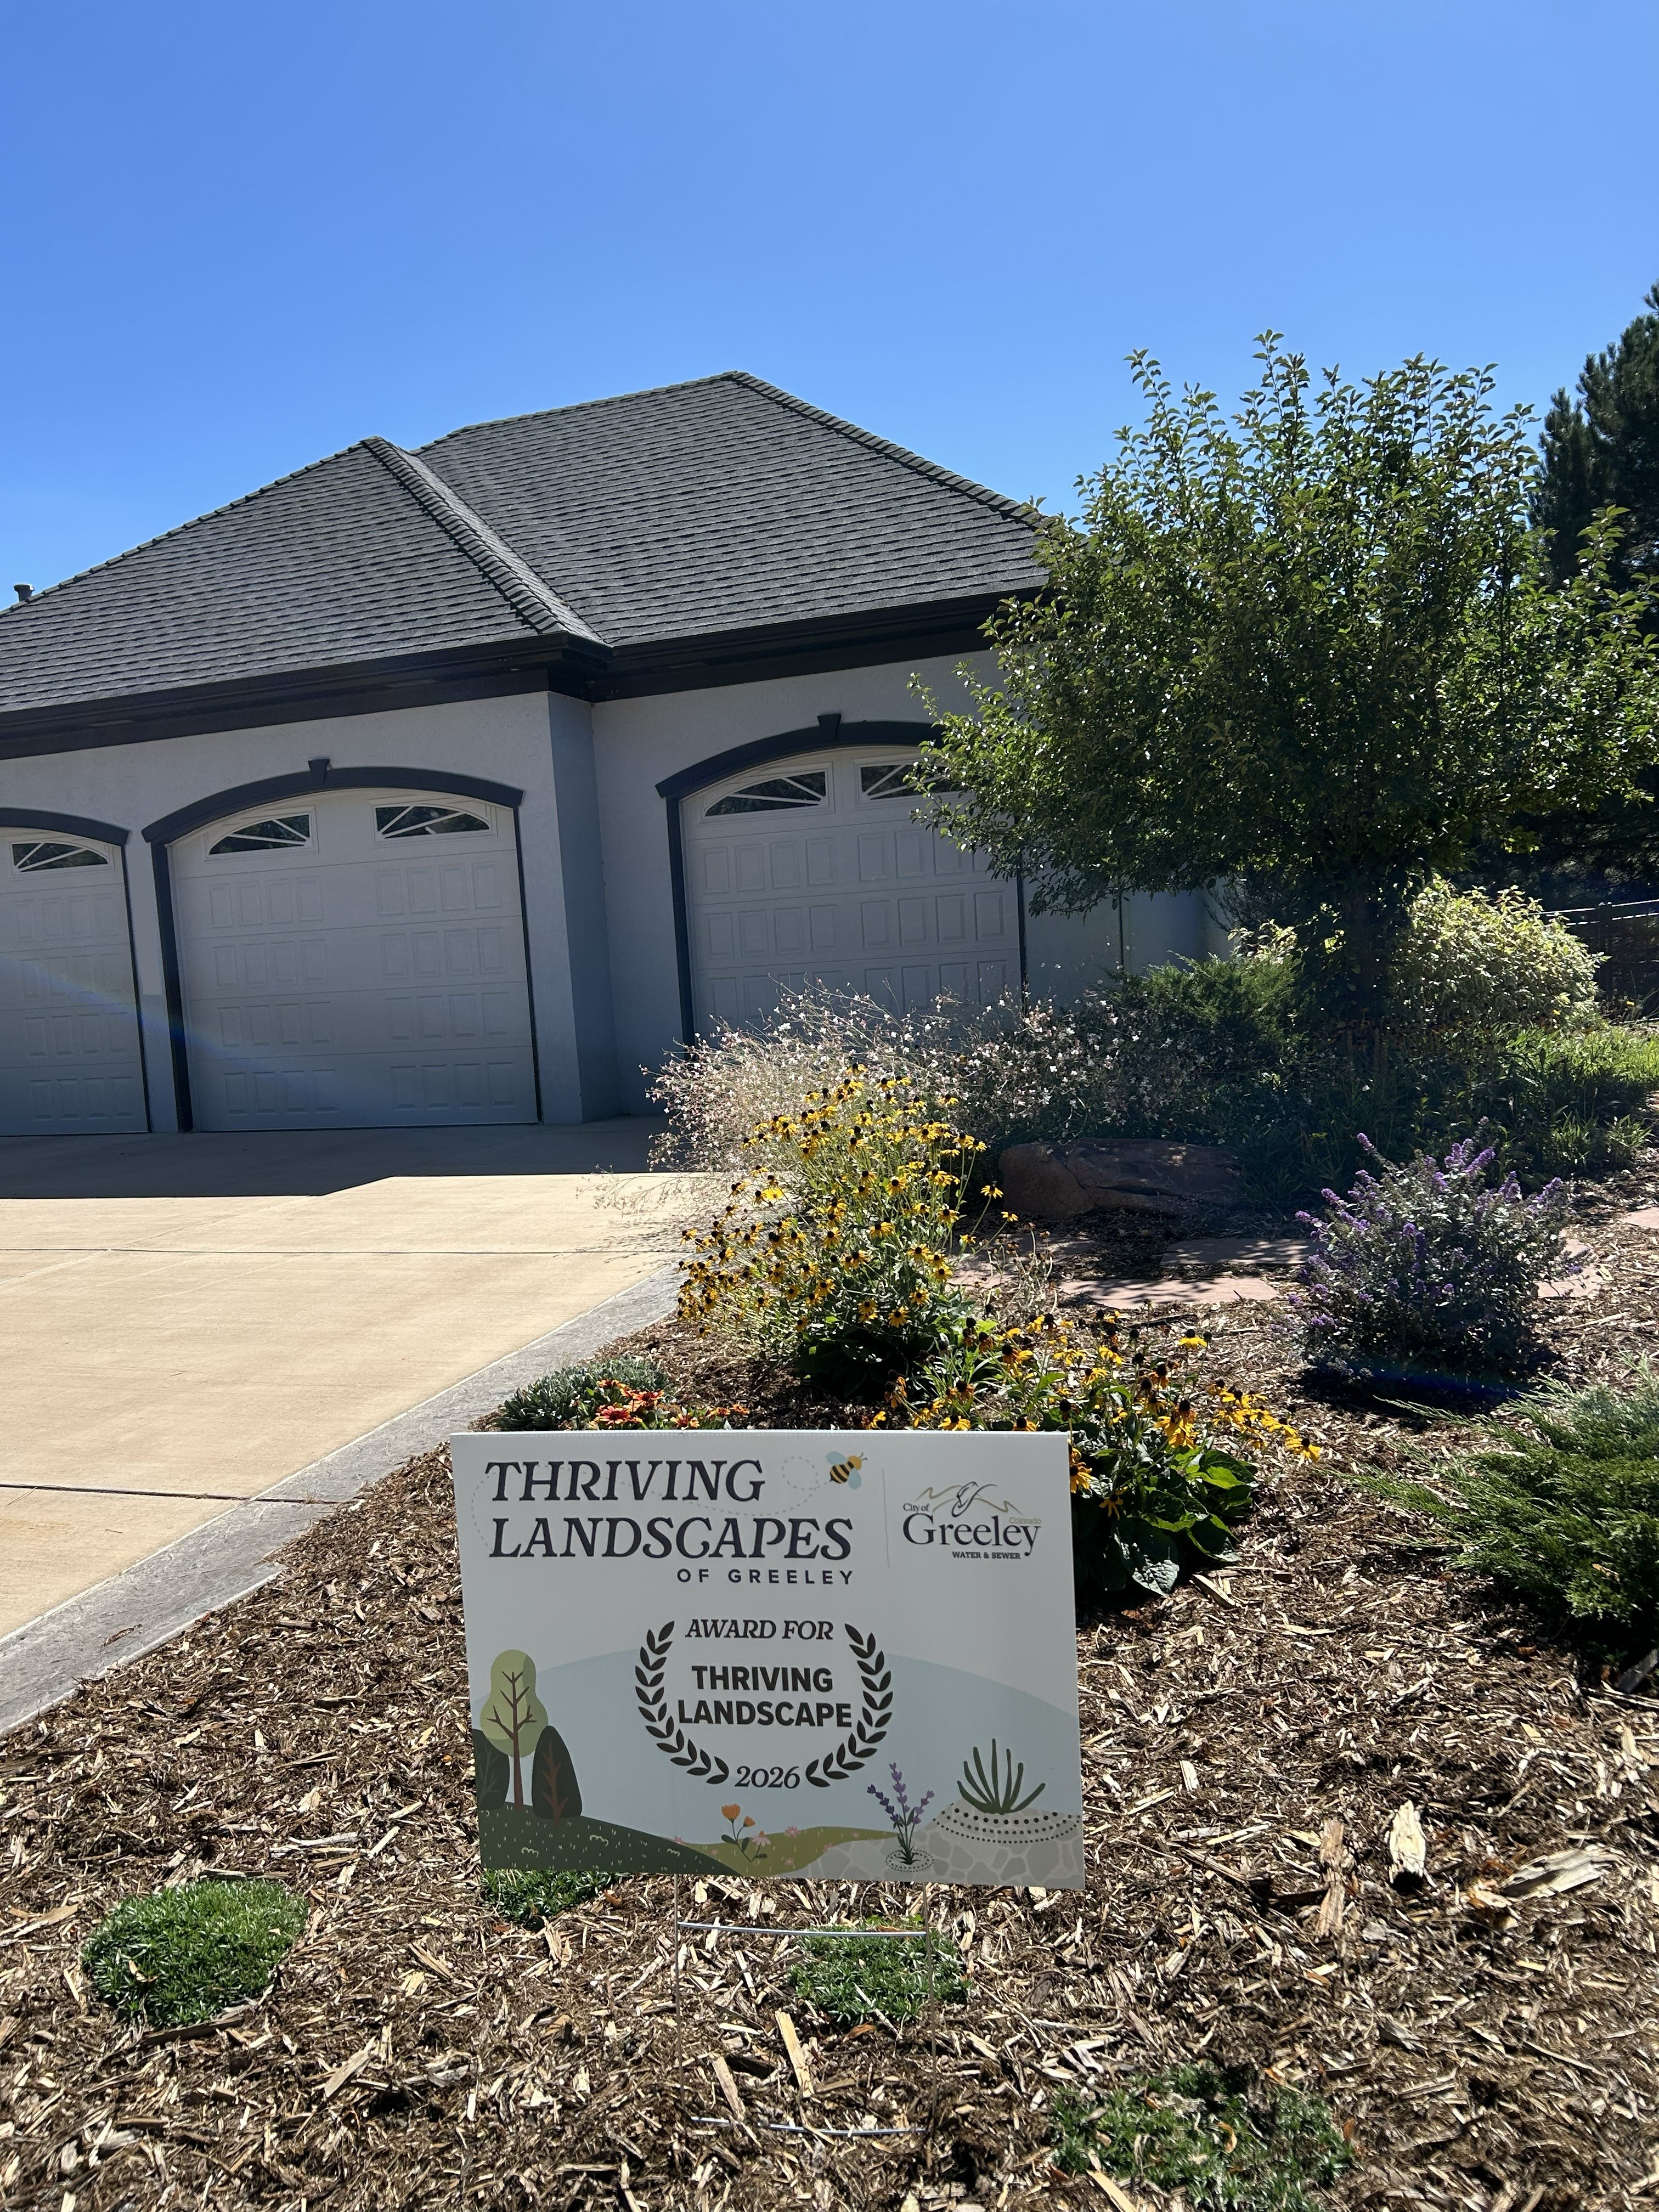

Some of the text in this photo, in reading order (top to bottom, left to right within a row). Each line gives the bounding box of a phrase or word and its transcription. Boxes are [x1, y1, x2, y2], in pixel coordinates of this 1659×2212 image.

[486, 1460, 765, 1503] THRIVING
[903, 1503, 930, 1513] City of
[489, 1517, 854, 1560] LANDSCAPES
[903, 1513, 1041, 1556] Greeley
[676, 1568, 854, 1585] OF GREELEY
[685, 1619, 833, 1640] AWARD FOR
[691, 1666, 833, 1692] THRIVING
[678, 1700, 852, 1728] LANDSCAPE
[735, 1766, 800, 1789] 2026
